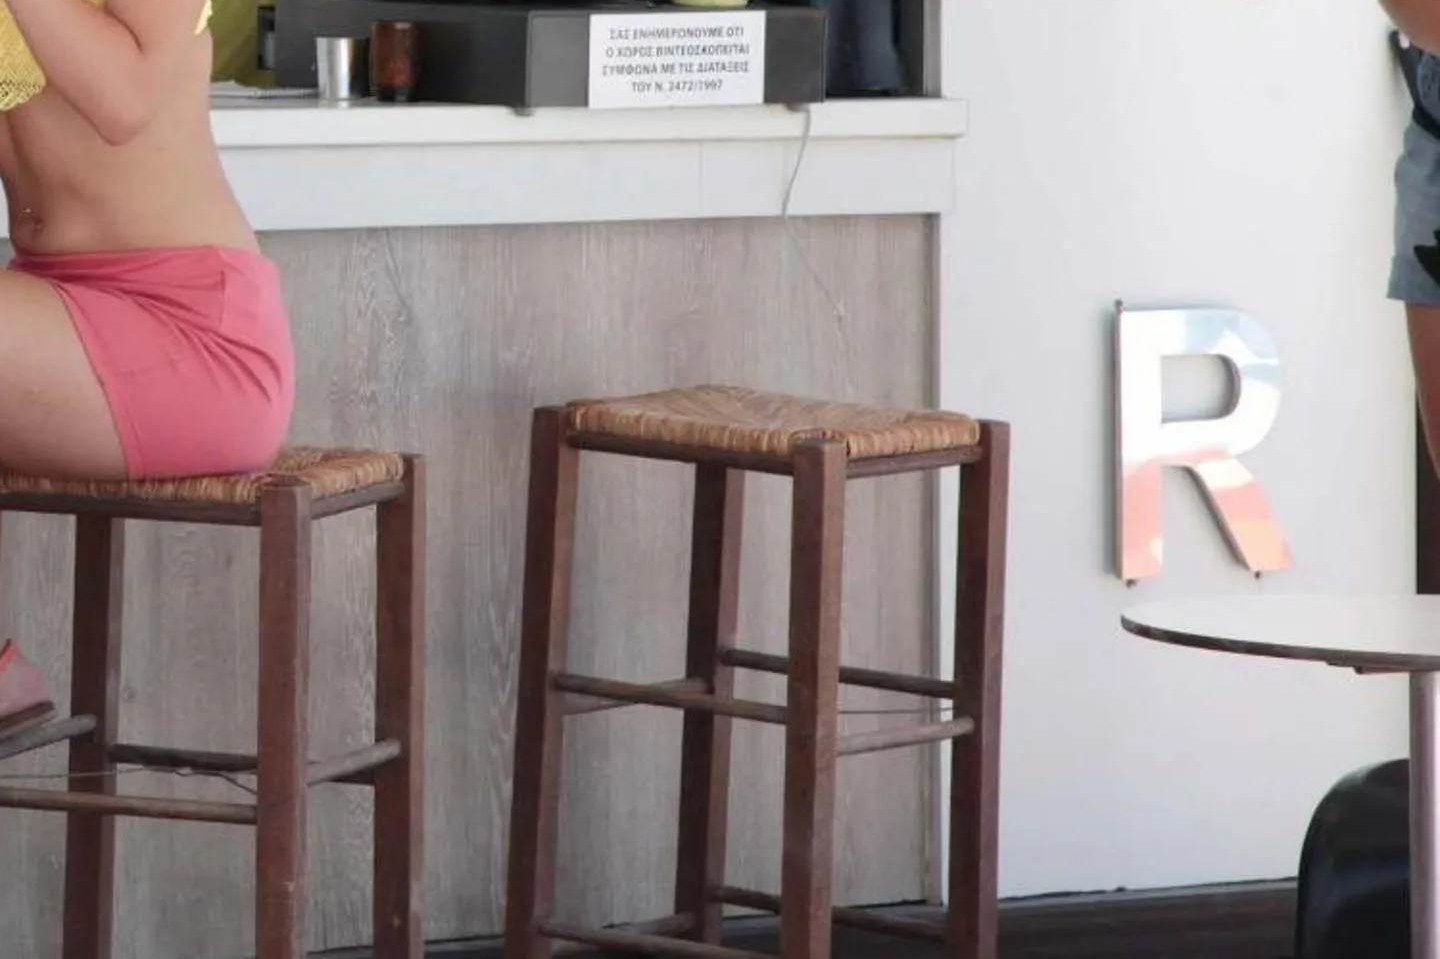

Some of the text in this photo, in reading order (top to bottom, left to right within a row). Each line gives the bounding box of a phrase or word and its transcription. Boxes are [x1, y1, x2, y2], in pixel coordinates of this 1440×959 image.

[610, 28, 630, 40] ΣΑΣ
[727, 25, 744, 37] ΟΤΙ
[606, 46, 614, 58] Ο
[616, 45, 652, 58] ΧΩΡΟΣ
[602, 60, 749, 77] ΣΥΜΦΩΝΑ ΜΕ ΤΙΣ ΔΙΑΤΑΞΕΙΣ
[632, 81, 651, 93] ΤΟΥ
